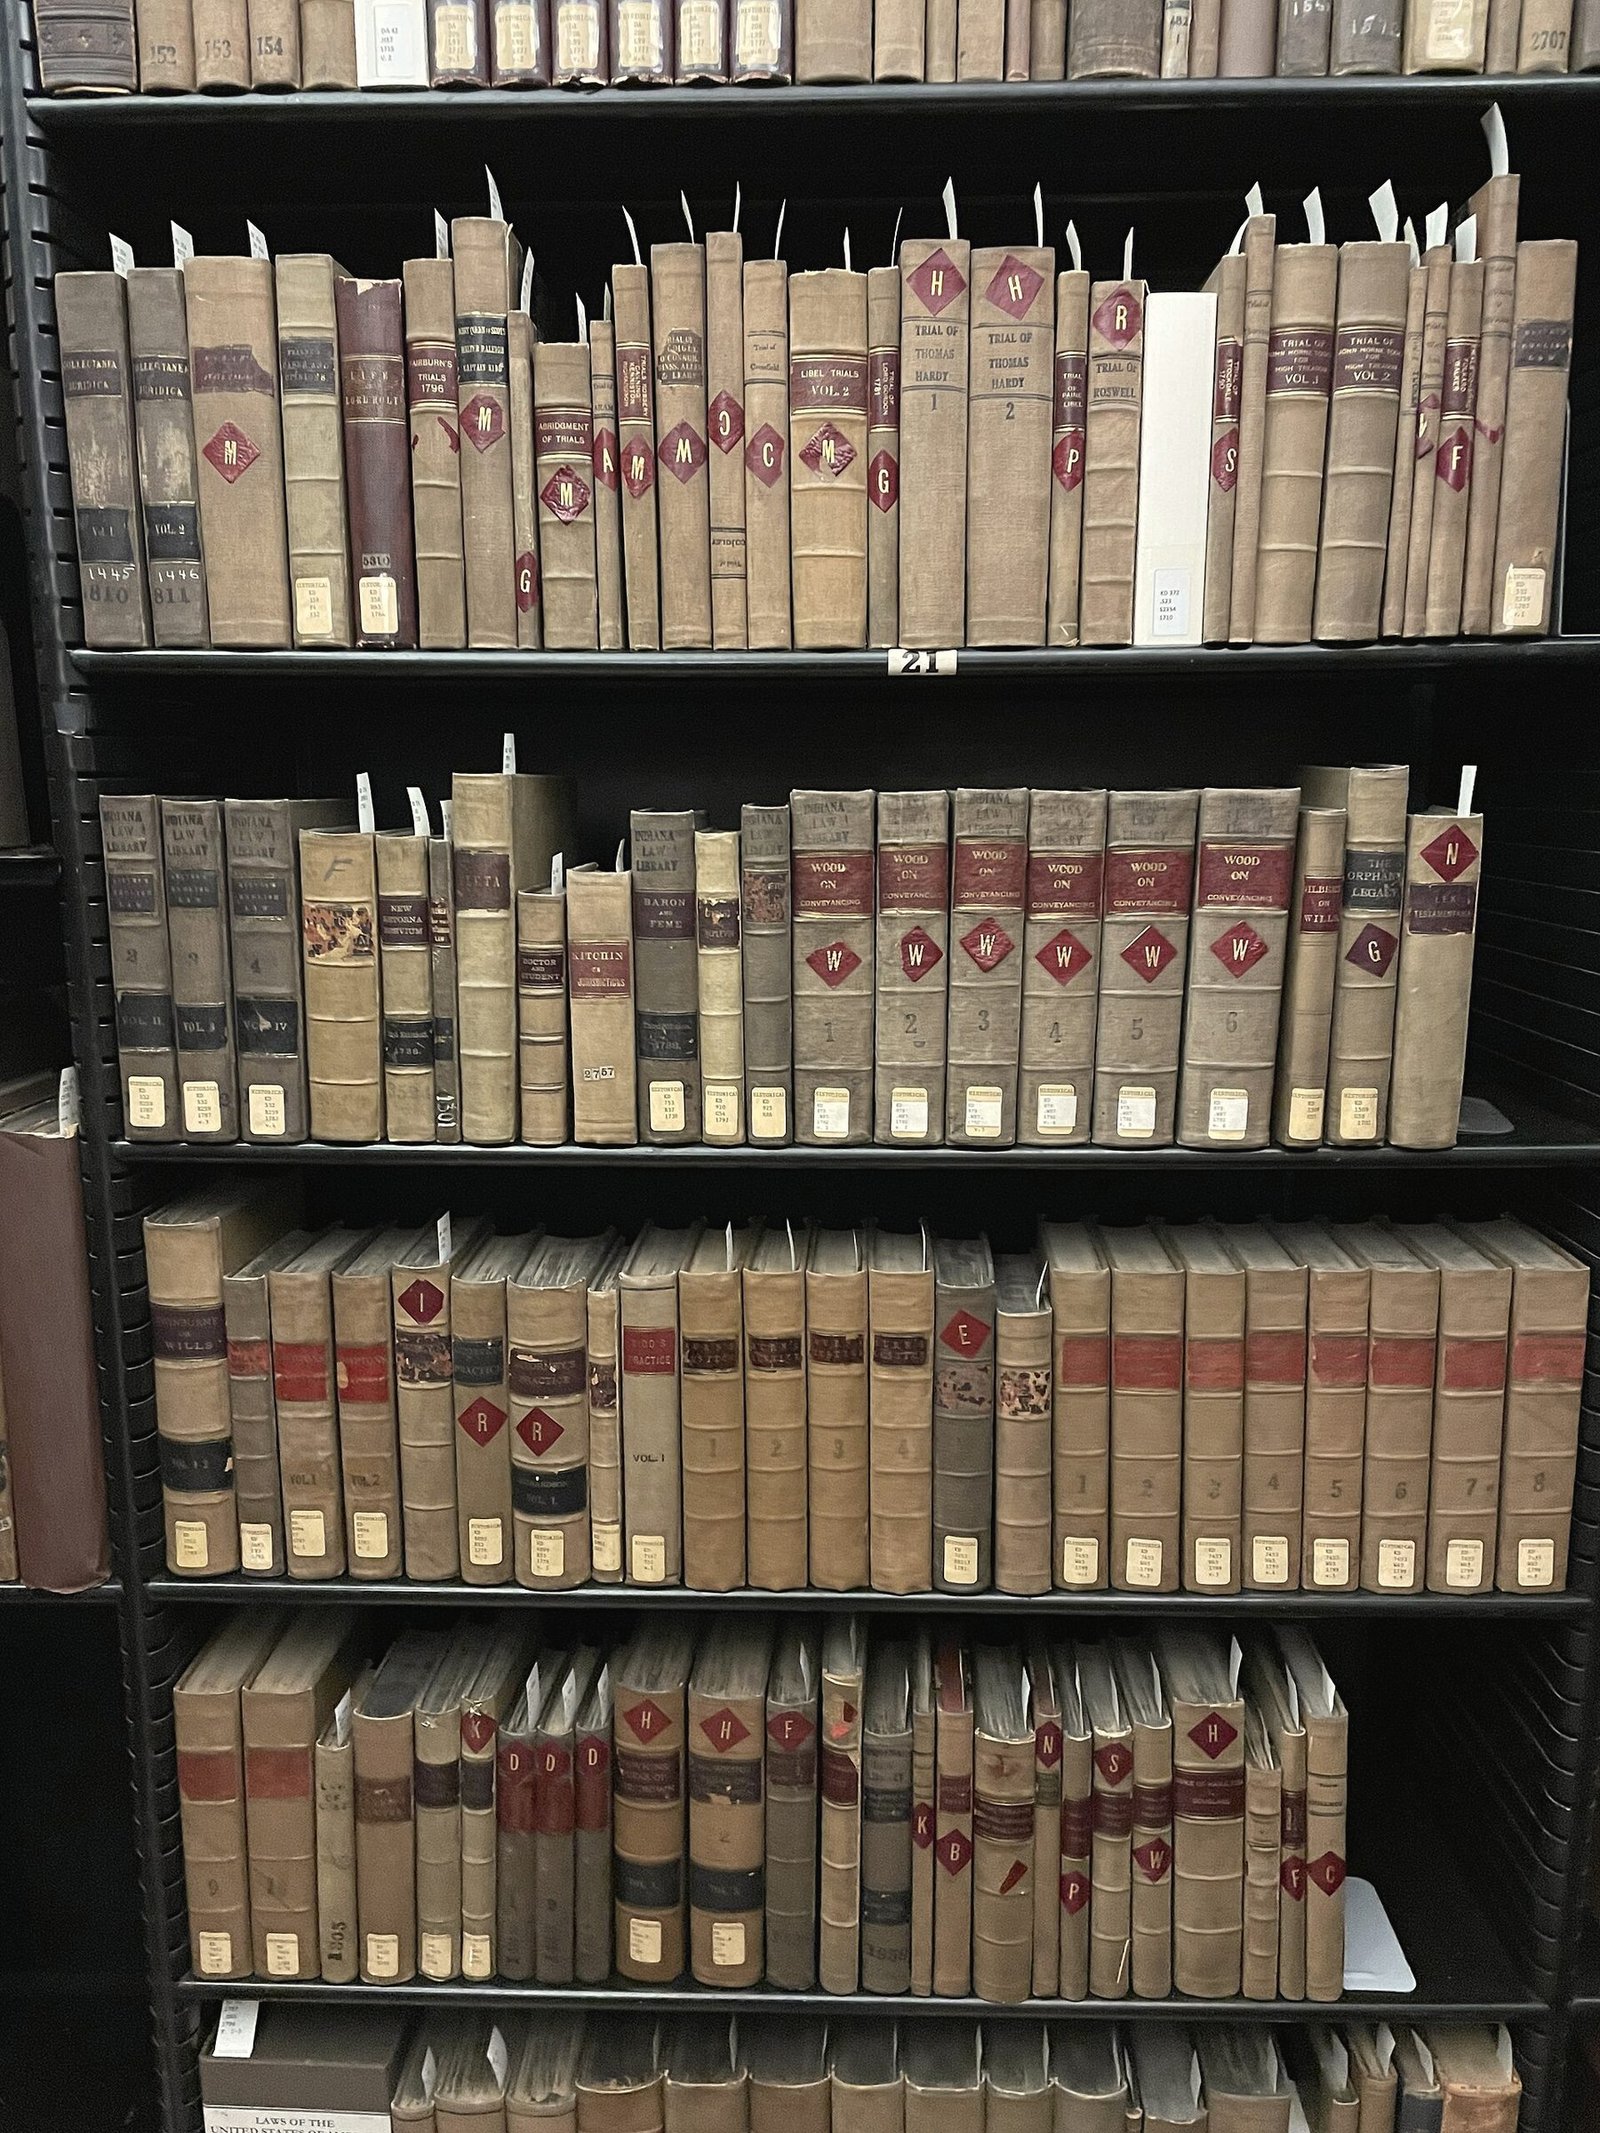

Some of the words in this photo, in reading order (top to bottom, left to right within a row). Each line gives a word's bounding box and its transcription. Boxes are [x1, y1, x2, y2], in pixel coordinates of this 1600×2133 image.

[205, 39, 232, 59] 153
[257, 36, 283, 56] 154
[1532, 30, 1566, 51] 2707
[930, 270, 943, 296] H
[1008, 275, 1023, 302] H
[1115, 304, 1127, 331] R
[915, 326, 943, 336] TRIAL
[947, 326, 959, 336] OF
[988, 333, 1016, 345] TRIAL
[1019, 332, 1032, 343] OF
[1281, 339, 1311, 347] TRIAL
[1350, 337, 1380, 345] TRIAL
[915, 348, 954, 360] THOMAS
[988, 357, 1029, 369] THOMAS
[801, 369, 824, 378] LIBEL
[830, 369, 859, 378] TRIALS
[915, 371, 948, 382] HARDY
[1063, 372, 1082, 380] TRIAL
[1096, 363, 1123, 374] TRIAL
[1126, 362, 1137, 373] OF
[1383, 372, 1391, 381] 2
[418, 374, 446, 382] TRIALS
[992, 377, 1025, 389] HARDY
[421, 384, 444, 393] 1796
[843, 386, 850, 396] 2
[1093, 387, 1136, 398] ROSWELL
[931, 393, 938, 411] 1
[1006, 402, 1015, 420] 2
[479, 406, 492, 432] M
[538, 423, 589, 431] ABRIDGMENT
[542, 435, 552, 444] OF
[556, 435, 585, 444] TRIALS
[763, 442, 774, 467] C
[822, 439, 835, 463] M
[1226, 448, 1237, 472] S
[1452, 445, 1463, 470] F
[603, 448, 614, 473] A
[631, 455, 645, 480] M
[1067, 448, 1079, 473] P
[878, 469, 889, 494] G
[560, 482, 573, 506] M
[89, 564, 135, 581] 1445
[159, 568, 199, 582] 1446
[520, 569, 531, 593] G
[902, 652, 939, 674] 21
[893, 855, 929, 864] WOOD
[972, 850, 1007, 860] WOOD
[1224, 855, 1260, 866] WOOD
[1446, 842, 1459, 865] N
[636, 860, 678, 872] LIBRARY
[811, 863, 846, 873] WOOD
[979, 867, 995, 876] ON
[1047, 864, 1083, 874] WOOD
[1130, 862, 1167, 872] WOOD
[1368, 859, 1391, 868] THE
[902, 870, 918, 879] ON
[1137, 877, 1155, 887] ON
[1231, 871, 1249, 880] ON
[820, 880, 836, 889] ON
[1054, 879, 1071, 889] ON
[644, 898, 685, 907] BARON
[650, 920, 683, 928] FEME
[979, 933, 996, 956] W
[1232, 938, 1248, 961] W
[1368, 941, 1381, 962] G
[522, 958, 556, 966] DOCTOR
[826, 950, 842, 971] W
[908, 944, 924, 966] W
[1056, 945, 1072, 967] W
[1145, 945, 1161, 967] W
[905, 1013, 917, 1034] 2
[978, 1010, 990, 1031] 3
[1132, 1018, 1143, 1039] 5
[1225, 1011, 1238, 1032] 6
[1049, 1022, 1062, 1043] 4
[584, 1066, 615, 1080] 2757
[958, 1324, 971, 1345] E
[478, 1412, 488, 1432] R
[532, 1421, 543, 1442] R
[1267, 1473, 1280, 1490] 4
[1331, 1479, 1342, 1498] 5
[1395, 1481, 1407, 1499] 6
[1466, 1477, 1477, 1495] 7
[1533, 1471, 1546, 1492] 8
[641, 1711, 651, 1729] H
[721, 1721, 731, 1740] H
[785, 1720, 794, 1739] F
[1208, 1724, 1218, 1742] H
[1044, 1735, 1053, 1754] N
[510, 1753, 520, 1771] D
[546, 1753, 556, 1772] D
[588, 1748, 598, 1766] D
[1109, 1755, 1119, 1773] S
[918, 1816, 927, 1834] K
[950, 1843, 960, 1861] B
[1150, 1850, 1165, 1869] W
[1291, 1869, 1300, 1888] F
[1069, 1882, 1080, 1900] P
[256, 2116, 287, 2127] LAWS
[289, 2118, 306, 2127] OF
[309, 2119, 335, 2128] THE
